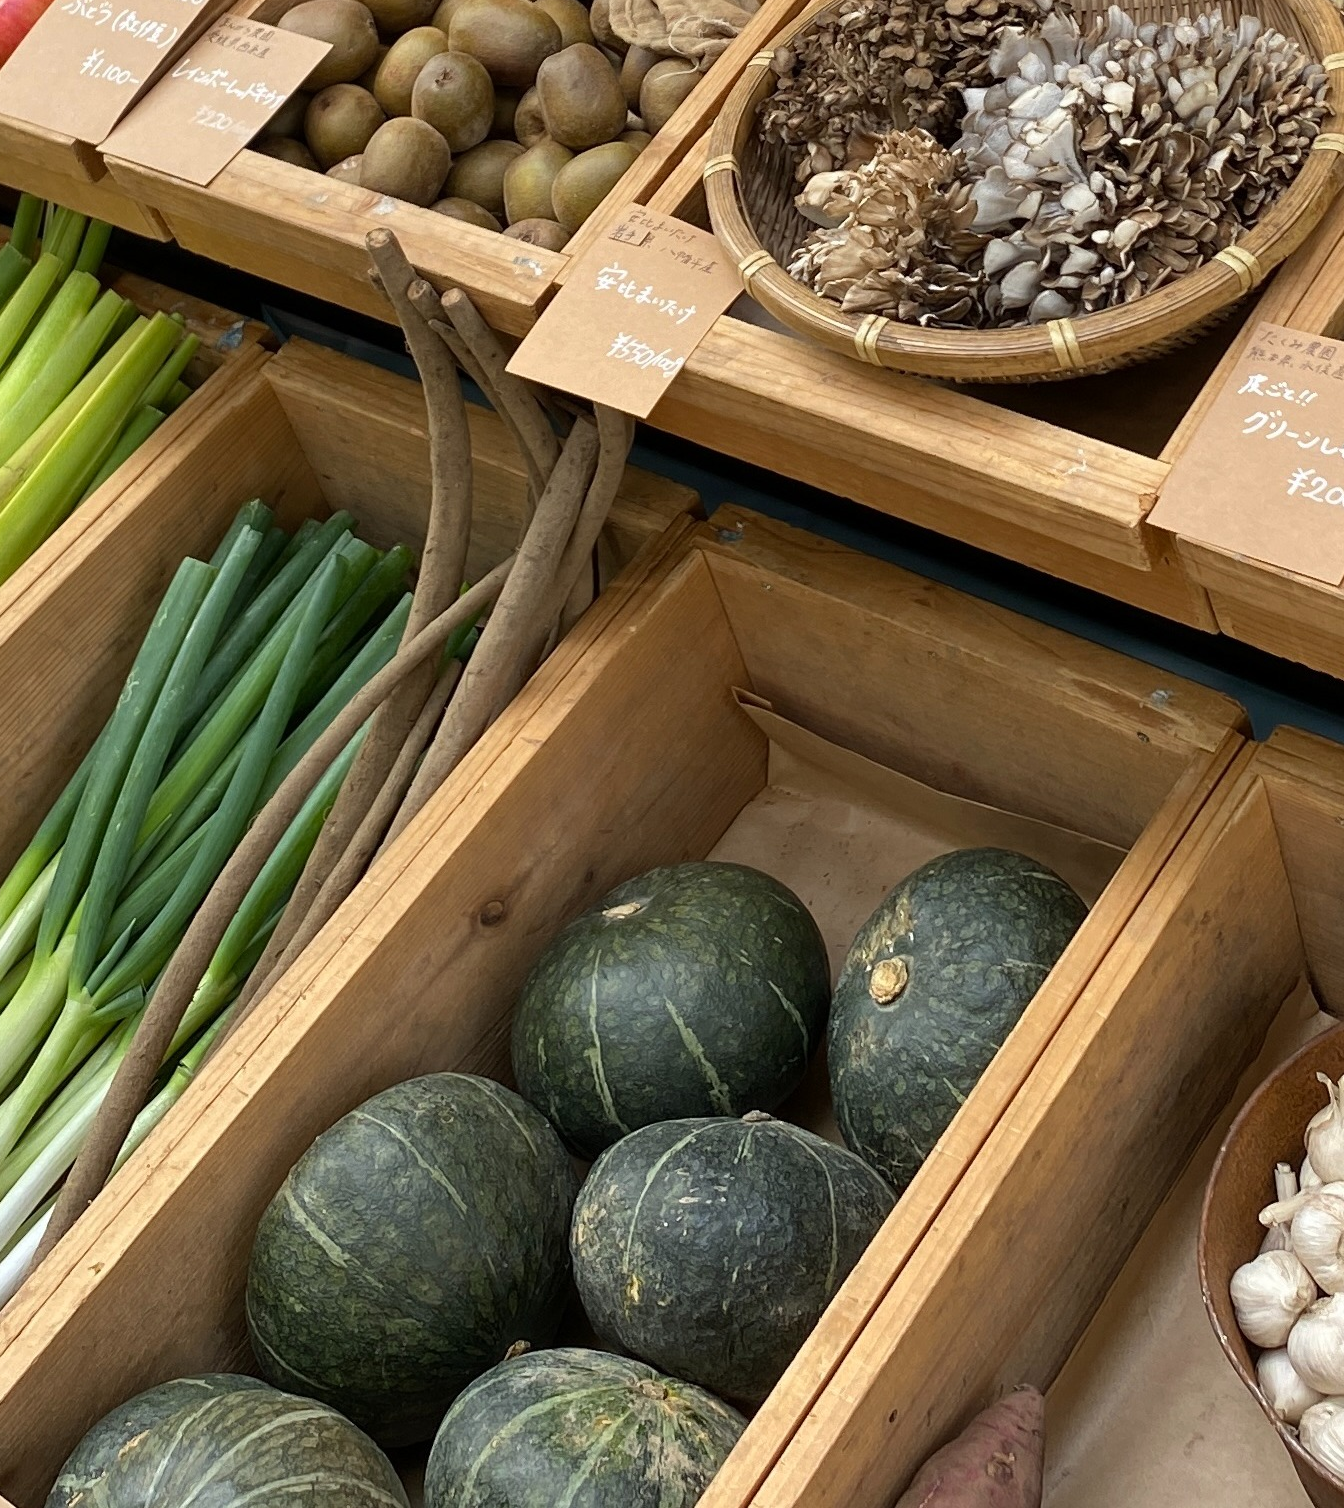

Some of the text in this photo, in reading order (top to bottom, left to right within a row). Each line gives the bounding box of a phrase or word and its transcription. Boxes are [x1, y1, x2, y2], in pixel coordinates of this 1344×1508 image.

[594, 261, 697, 326] 安比まいたけ
[1259, 330, 1338, 362] たくみ農園
